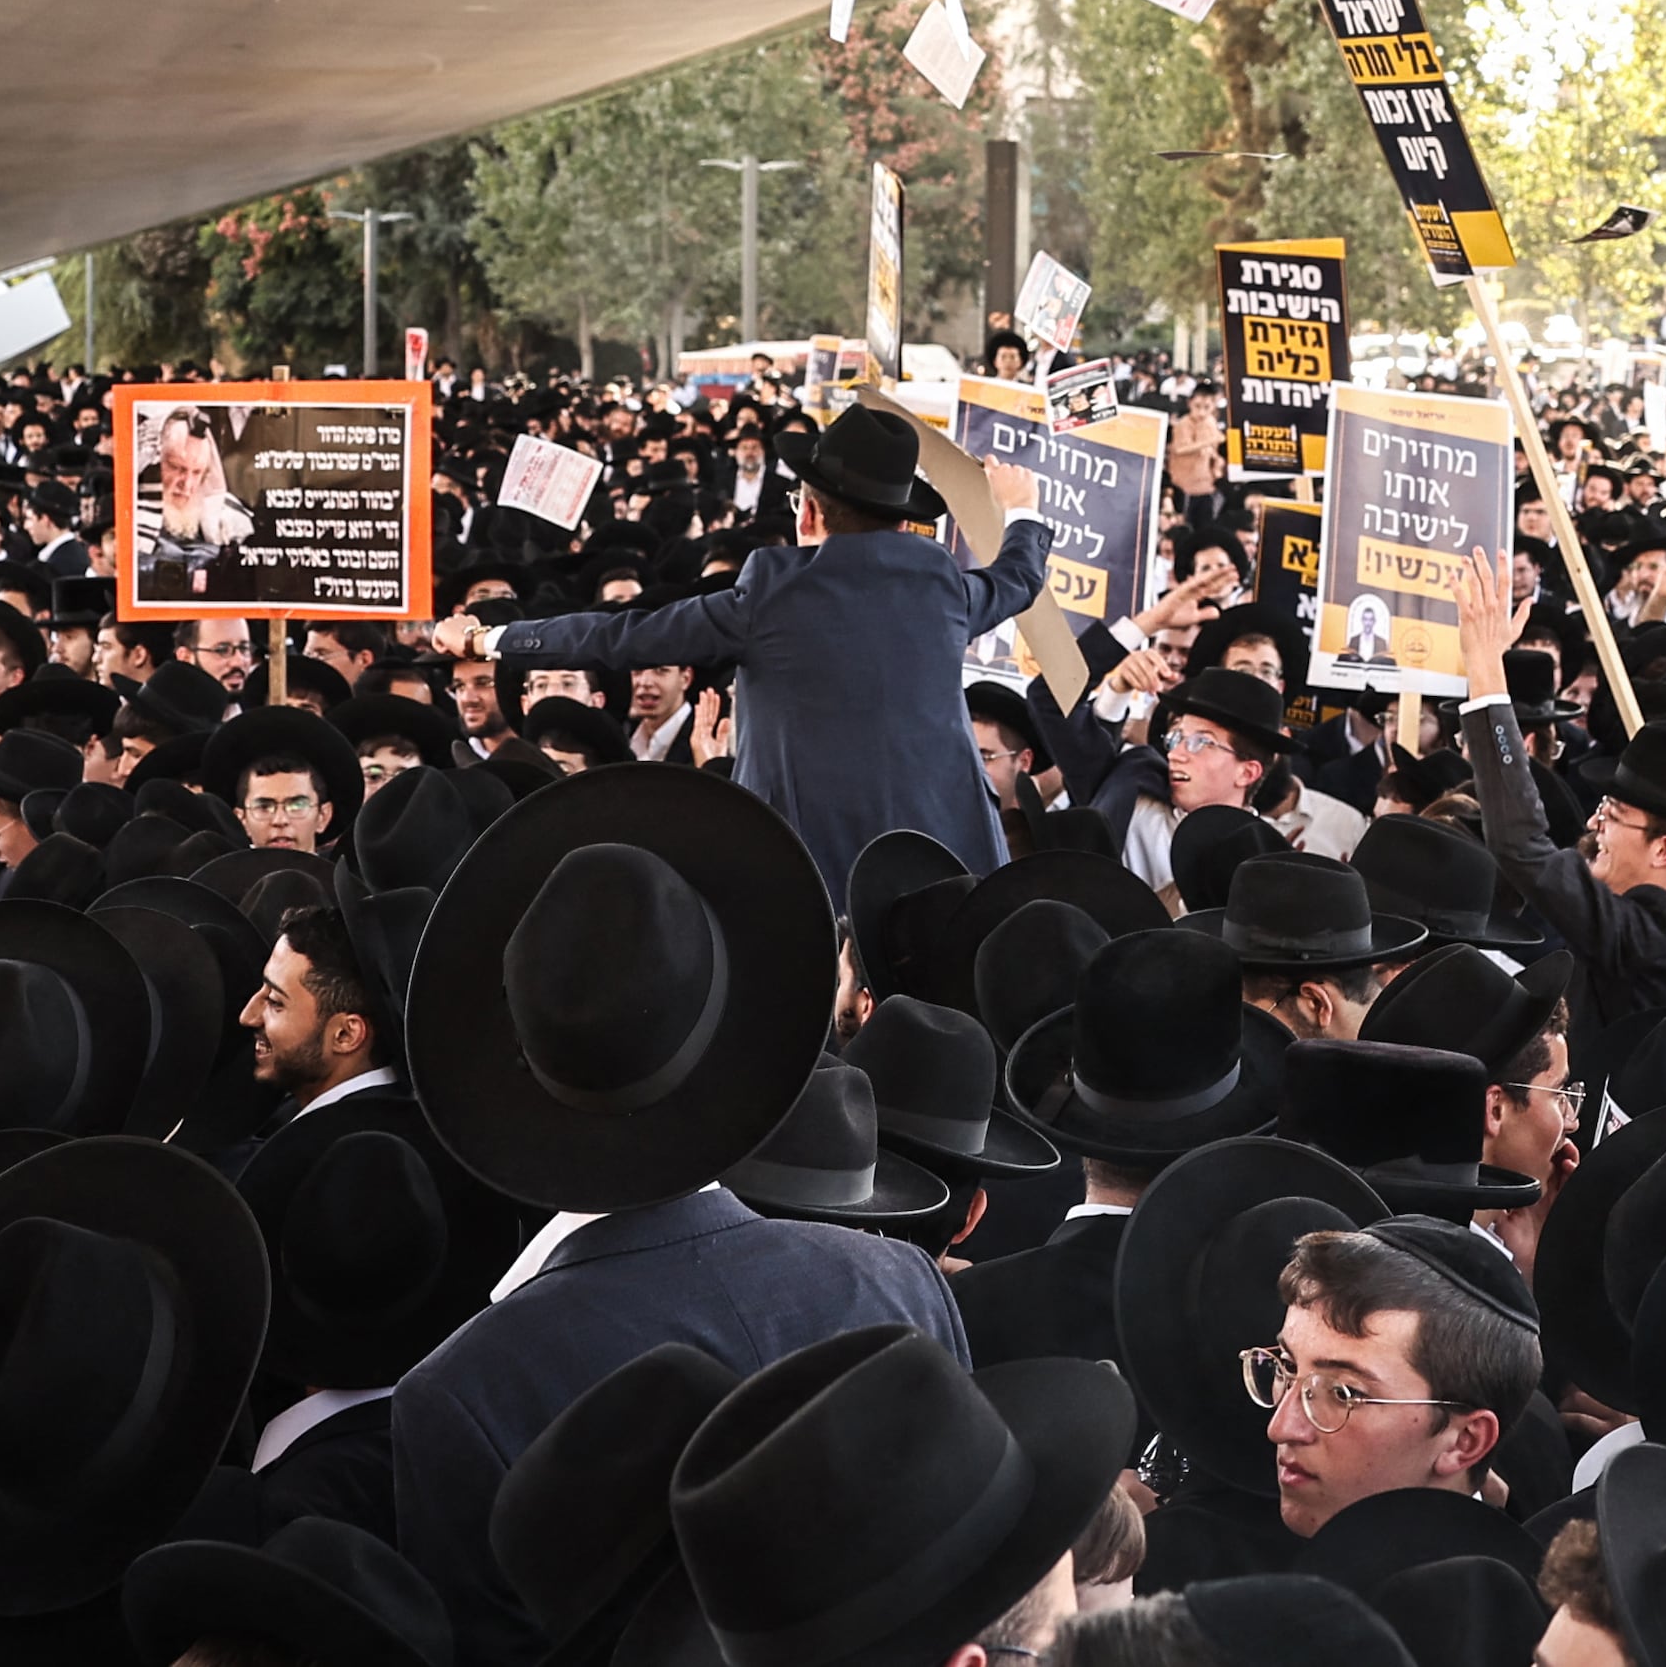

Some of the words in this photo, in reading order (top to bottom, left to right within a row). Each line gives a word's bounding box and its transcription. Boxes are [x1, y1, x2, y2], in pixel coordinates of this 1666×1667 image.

[1343, 44, 1396, 78] תורה
[1396, 35, 1438, 76] בלי
[1364, 89, 1414, 124] זכות
[1414, 88, 1452, 132] אין
[1397, 135, 1449, 179] קיום
[1240, 260, 1322, 290] סגירת
[1227, 289, 1340, 323] הישיבות
[1249, 321, 1323, 348] גזירת
[1257, 348, 1319, 375] כליה
[317, 426, 346, 443] הדור
[1246, 438, 1297, 452] התורה
[992, 422, 1117, 488] מחזירים
[1363, 429, 1477, 478] מחזירים
[266, 488, 303, 509] לצבא
[304, 490, 358, 509] המתגייס
[1034, 472, 1086, 515] אות
[1384, 470, 1450, 507] אותו
[275, 519, 314, 537] מצבא
[316, 520, 346, 539] עריק
[348, 520, 373, 539] הוא
[375, 520, 399, 539] הרי
[1364, 504, 1469, 548] לישיבה
[239, 546, 283, 566] ישראל
[332, 549, 366, 568] ובוגד
[368, 550, 399, 569] השם
